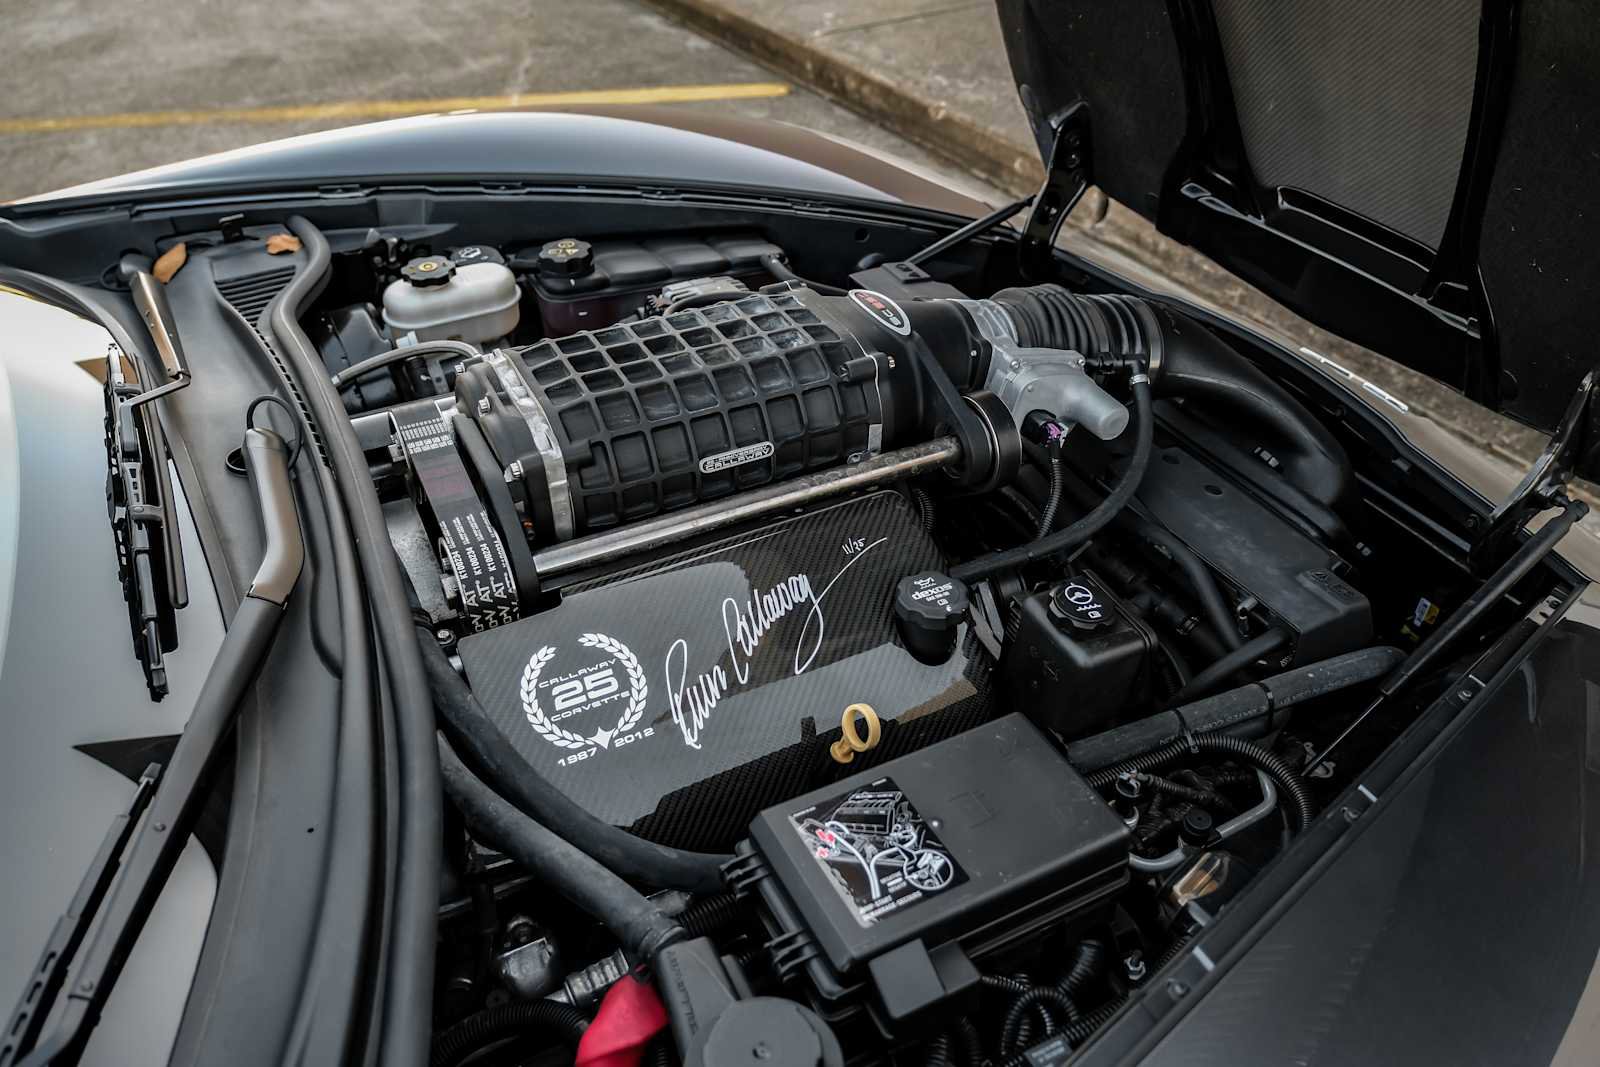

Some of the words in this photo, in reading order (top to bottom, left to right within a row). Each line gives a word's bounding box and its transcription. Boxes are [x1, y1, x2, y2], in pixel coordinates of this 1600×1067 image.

[451, 550, 469, 580] K100234
[465, 546, 482, 576] K100234
[480, 542, 497, 572] K100234
[911, 584, 953, 600] dexos
[538, 658, 618, 689] CALLAWAY
[551, 668, 619, 711] 25
[551, 690, 631, 722] CORVETTE
[614, 727, 656, 748] 2012
[557, 747, 598, 767] 1987
